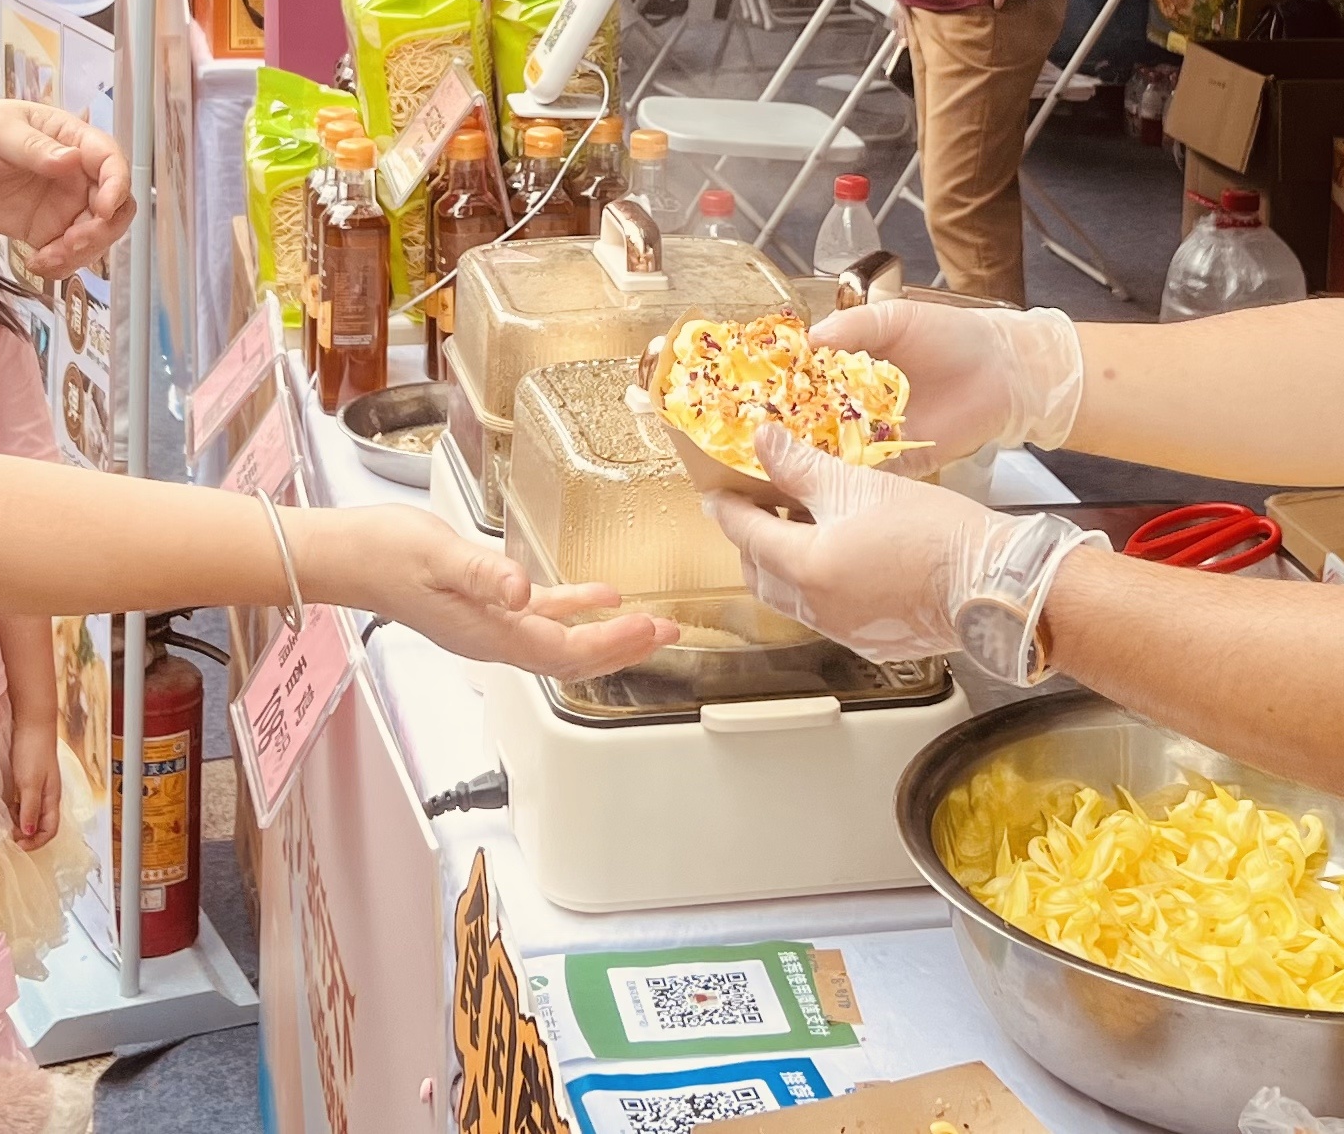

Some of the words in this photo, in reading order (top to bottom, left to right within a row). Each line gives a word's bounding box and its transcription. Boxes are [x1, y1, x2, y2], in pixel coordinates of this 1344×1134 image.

[777, 950, 832, 1038] 推荐使用微信支付
